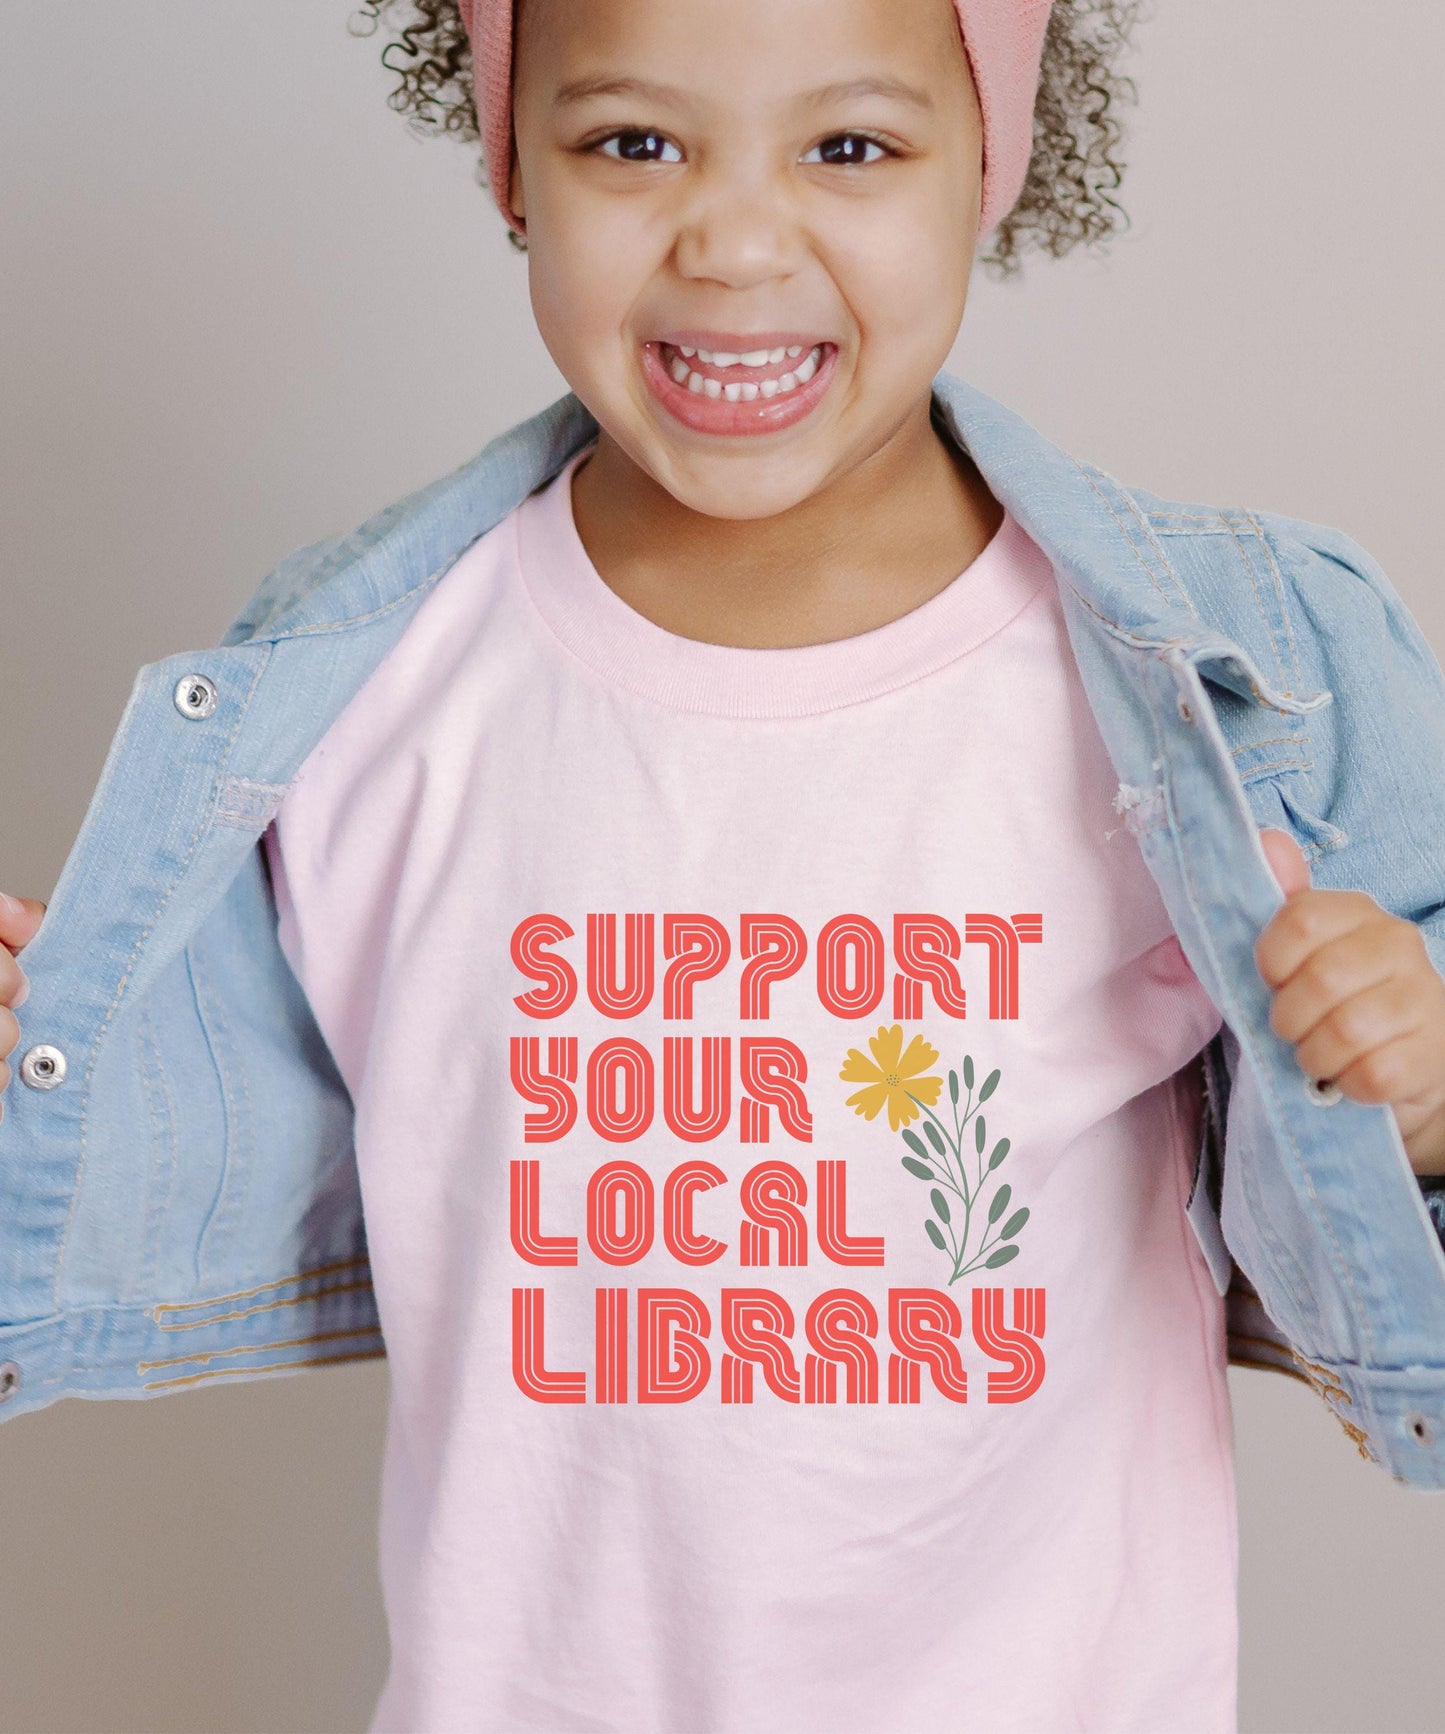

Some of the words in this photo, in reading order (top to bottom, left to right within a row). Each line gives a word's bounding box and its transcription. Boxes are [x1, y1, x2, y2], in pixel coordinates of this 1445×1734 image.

[510, 913, 1043, 1020] SUPPORT
[509, 1036, 813, 1143] YOUR
[509, 1160, 885, 1267] LOCAL
[511, 1287, 1046, 1404] LIBRARY
